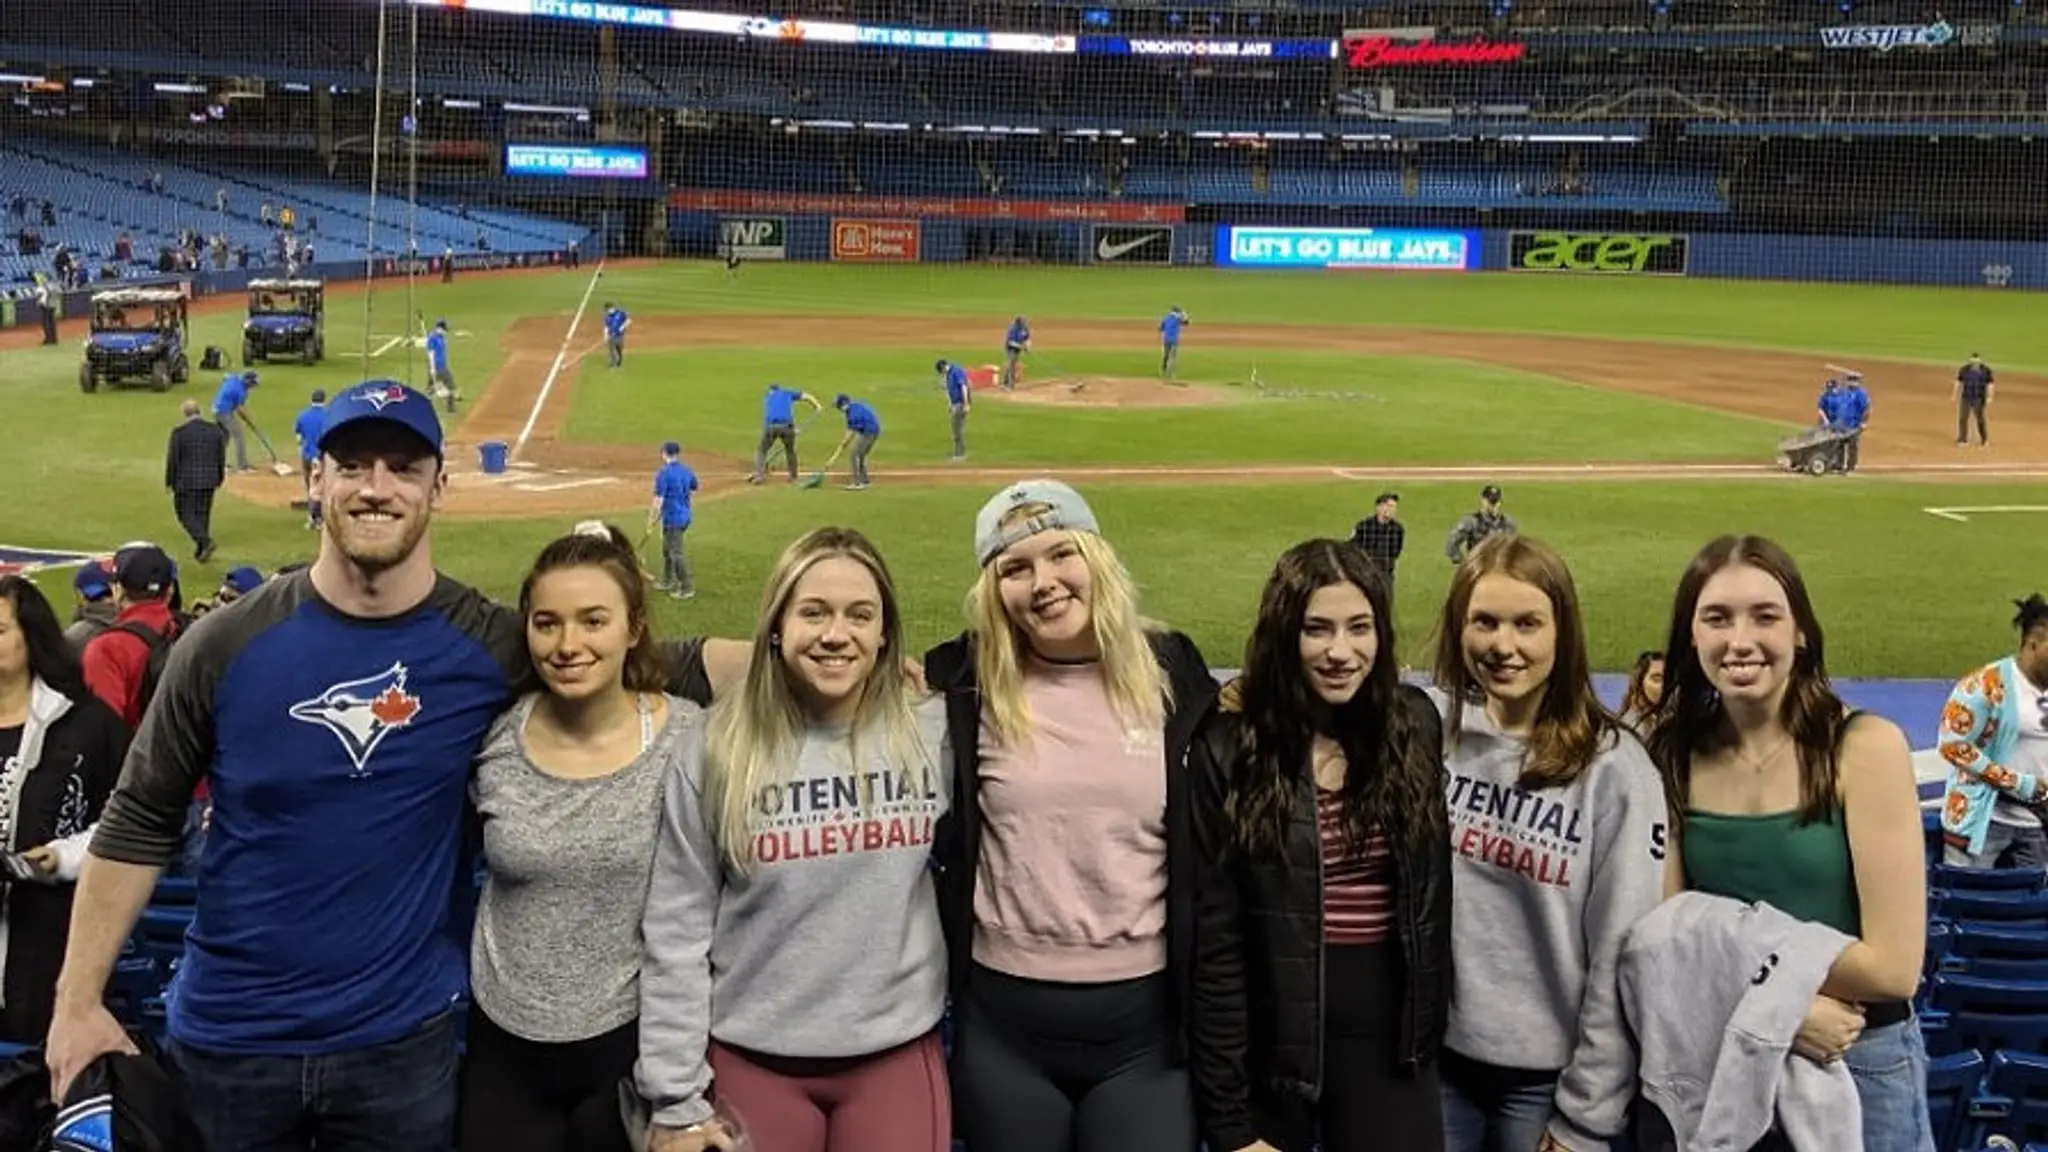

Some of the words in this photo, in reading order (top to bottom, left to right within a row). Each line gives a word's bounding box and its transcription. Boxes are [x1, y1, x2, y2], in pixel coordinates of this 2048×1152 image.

[1131, 40, 1192, 54] TORONTO
[1208, 42, 1238, 55] BLUE
[1240, 42, 1271, 55] JAYS
[1344, 36, 1526, 68] Budweiser
[1820, 26, 1926, 51] WESTJET
[548, 154, 569, 167] GO
[572, 155, 603, 168] BLUE
[1239, 236, 1292, 258] LET'S
[1297, 236, 1332, 258] GO
[1338, 237, 1393, 260] BLUE
[1523, 231, 1672, 271] acer
[752, 767, 937, 816] OTENTIAL
[1447, 775, 1582, 844] TENTIAL
